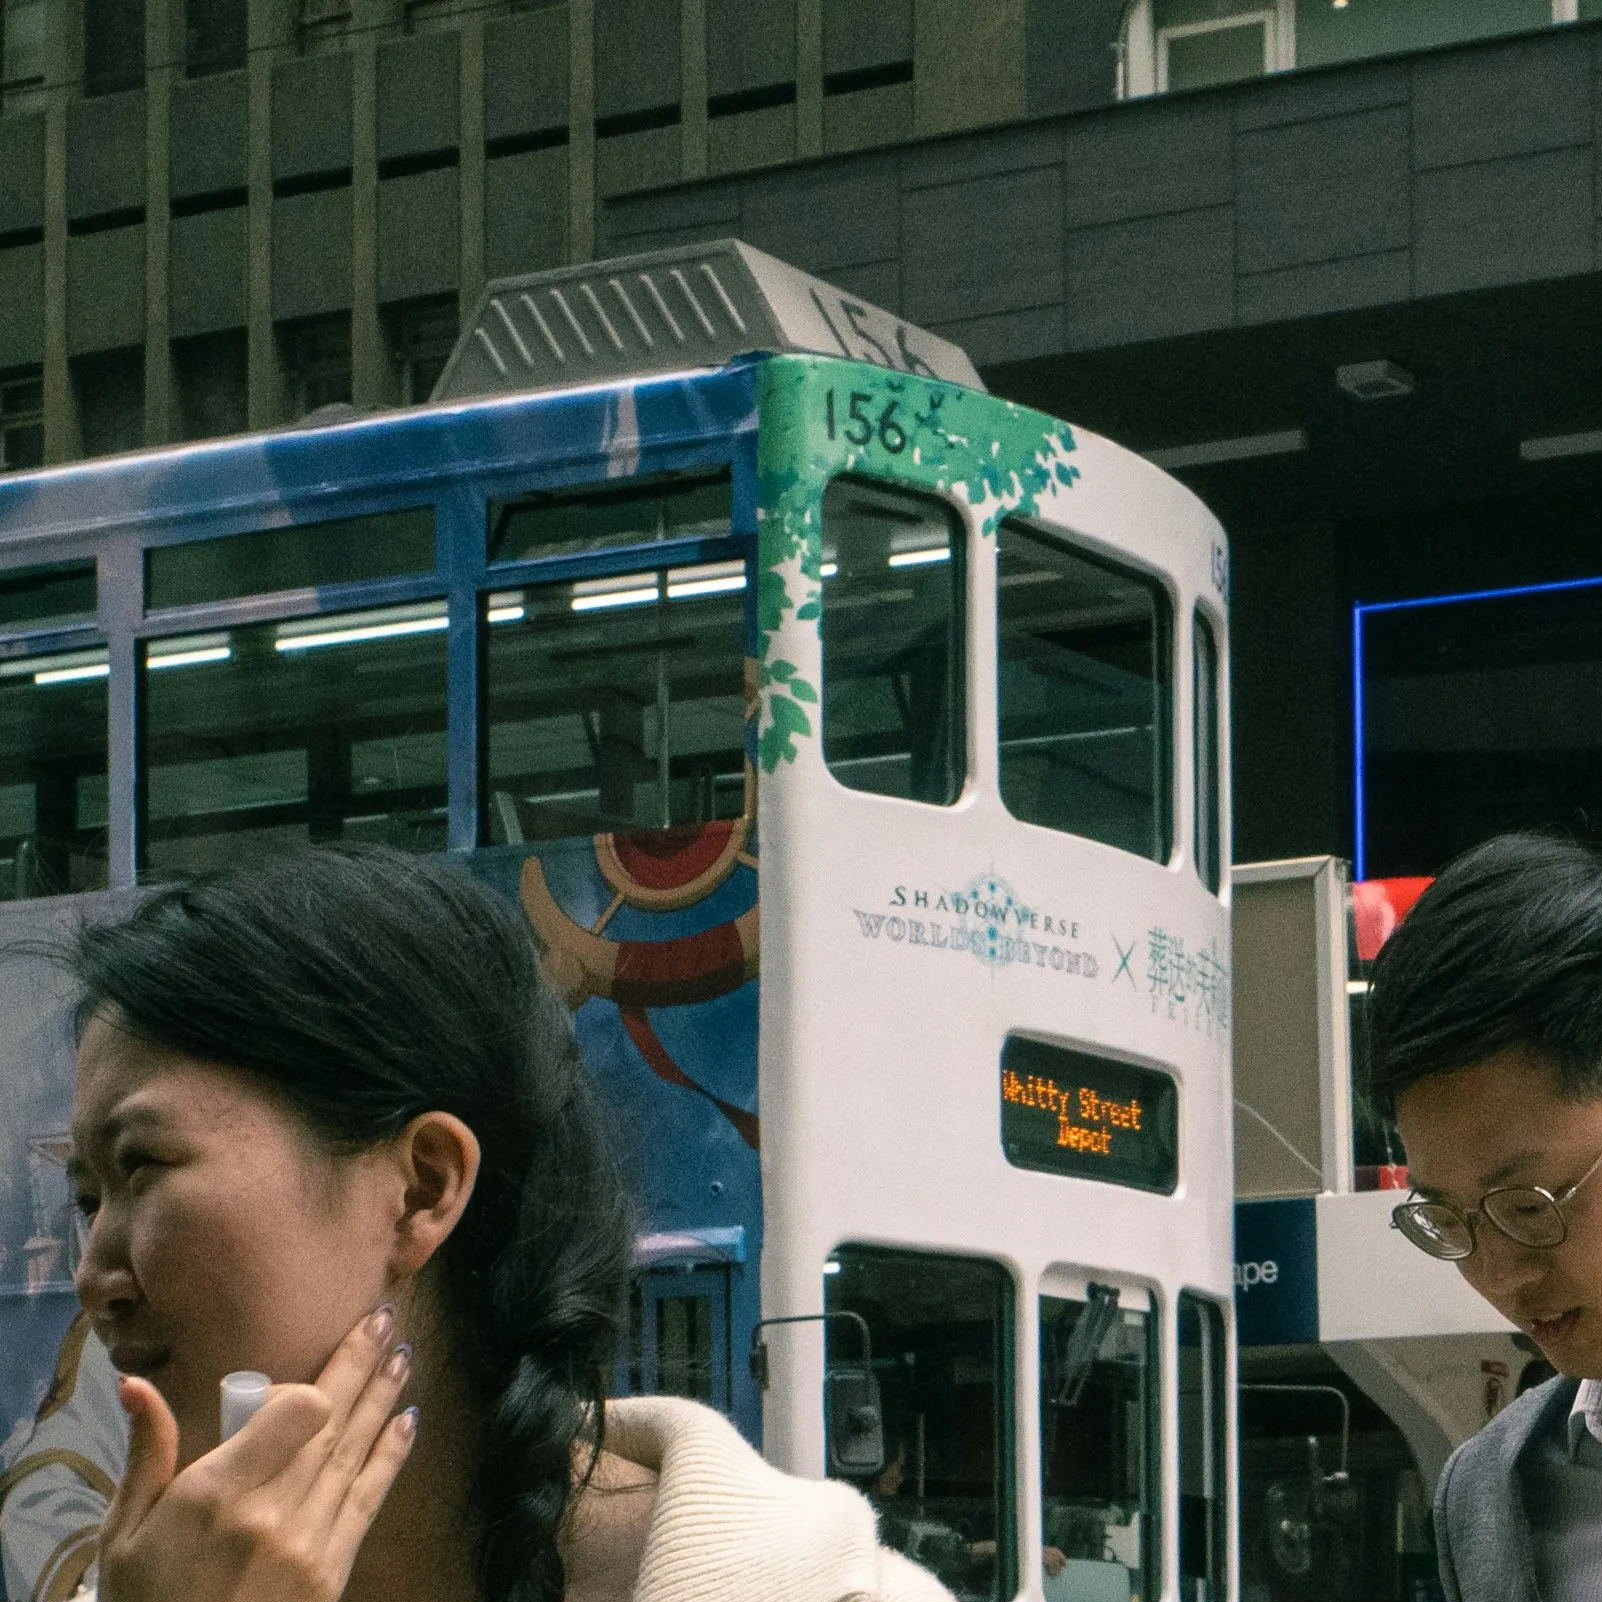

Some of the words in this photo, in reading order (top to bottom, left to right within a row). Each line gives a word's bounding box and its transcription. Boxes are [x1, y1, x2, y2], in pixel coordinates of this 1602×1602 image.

[826, 386, 906, 454] 156
[852, 908, 989, 960] WORLDS
[999, 930, 1101, 980] BEYOND
[888, 884, 1080, 940] SHADOWVERSE
[1002, 1068, 1070, 1121] Whitty
[1079, 1086, 1142, 1132] Street
[1056, 1123, 1112, 1156] Depot
